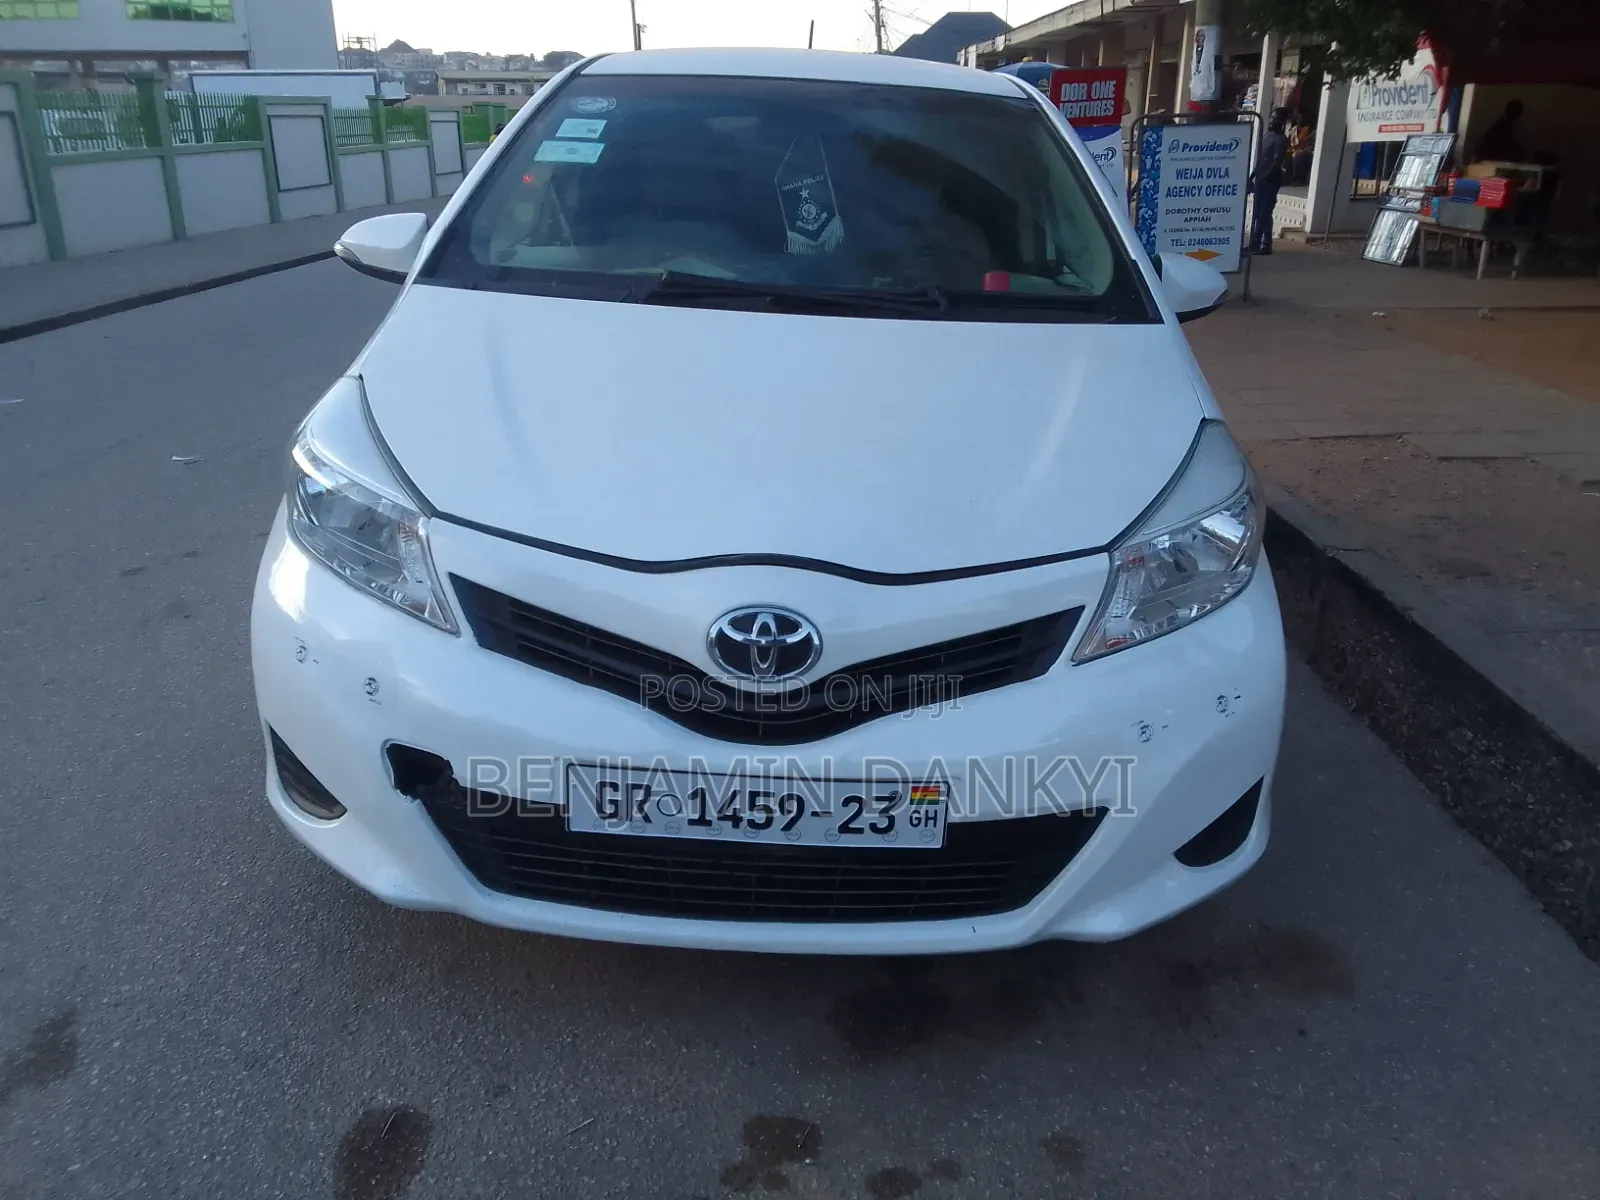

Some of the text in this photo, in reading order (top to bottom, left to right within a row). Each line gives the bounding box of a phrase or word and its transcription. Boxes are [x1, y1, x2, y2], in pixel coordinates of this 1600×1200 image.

[1060, 80, 1117, 102] DOR ONE
[1371, 82, 1429, 108] Provident
[1059, 99, 1115, 119] VENTURES
[1181, 140, 1235, 153] Provident
[802, 174, 825, 185] POLICE
[1176, 166, 1230, 180] WEIJA DVLA
[1165, 184, 1238, 198] AGENCY OFFICE
[1165, 206, 1232, 215] DOROTHY OWUSU
[1171, 239, 1186, 247] TEL:
[594, 780, 654, 824] GR
[908, 808, 939, 829] GH
